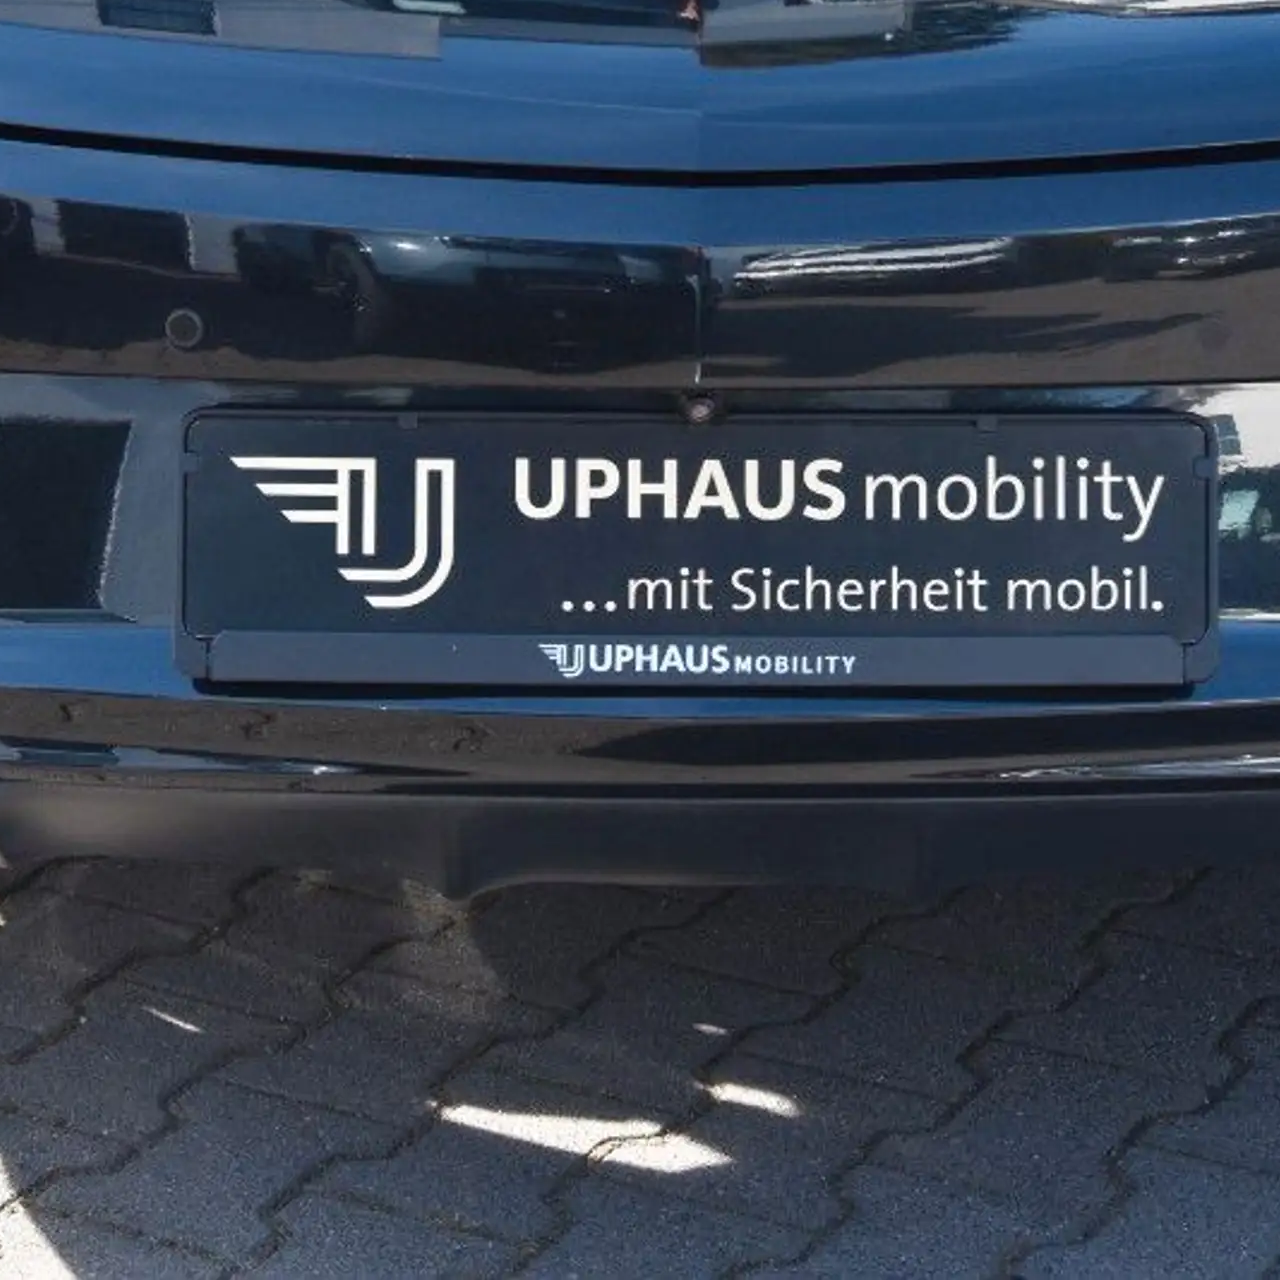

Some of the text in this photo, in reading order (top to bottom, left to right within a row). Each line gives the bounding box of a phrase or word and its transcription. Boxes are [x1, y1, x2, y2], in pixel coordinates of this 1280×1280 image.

[513, 454, 1165, 543] UPHAUS mobility
[730, 565, 989, 612] Sicherheit
[1006, 565, 1164, 612] mobil.
